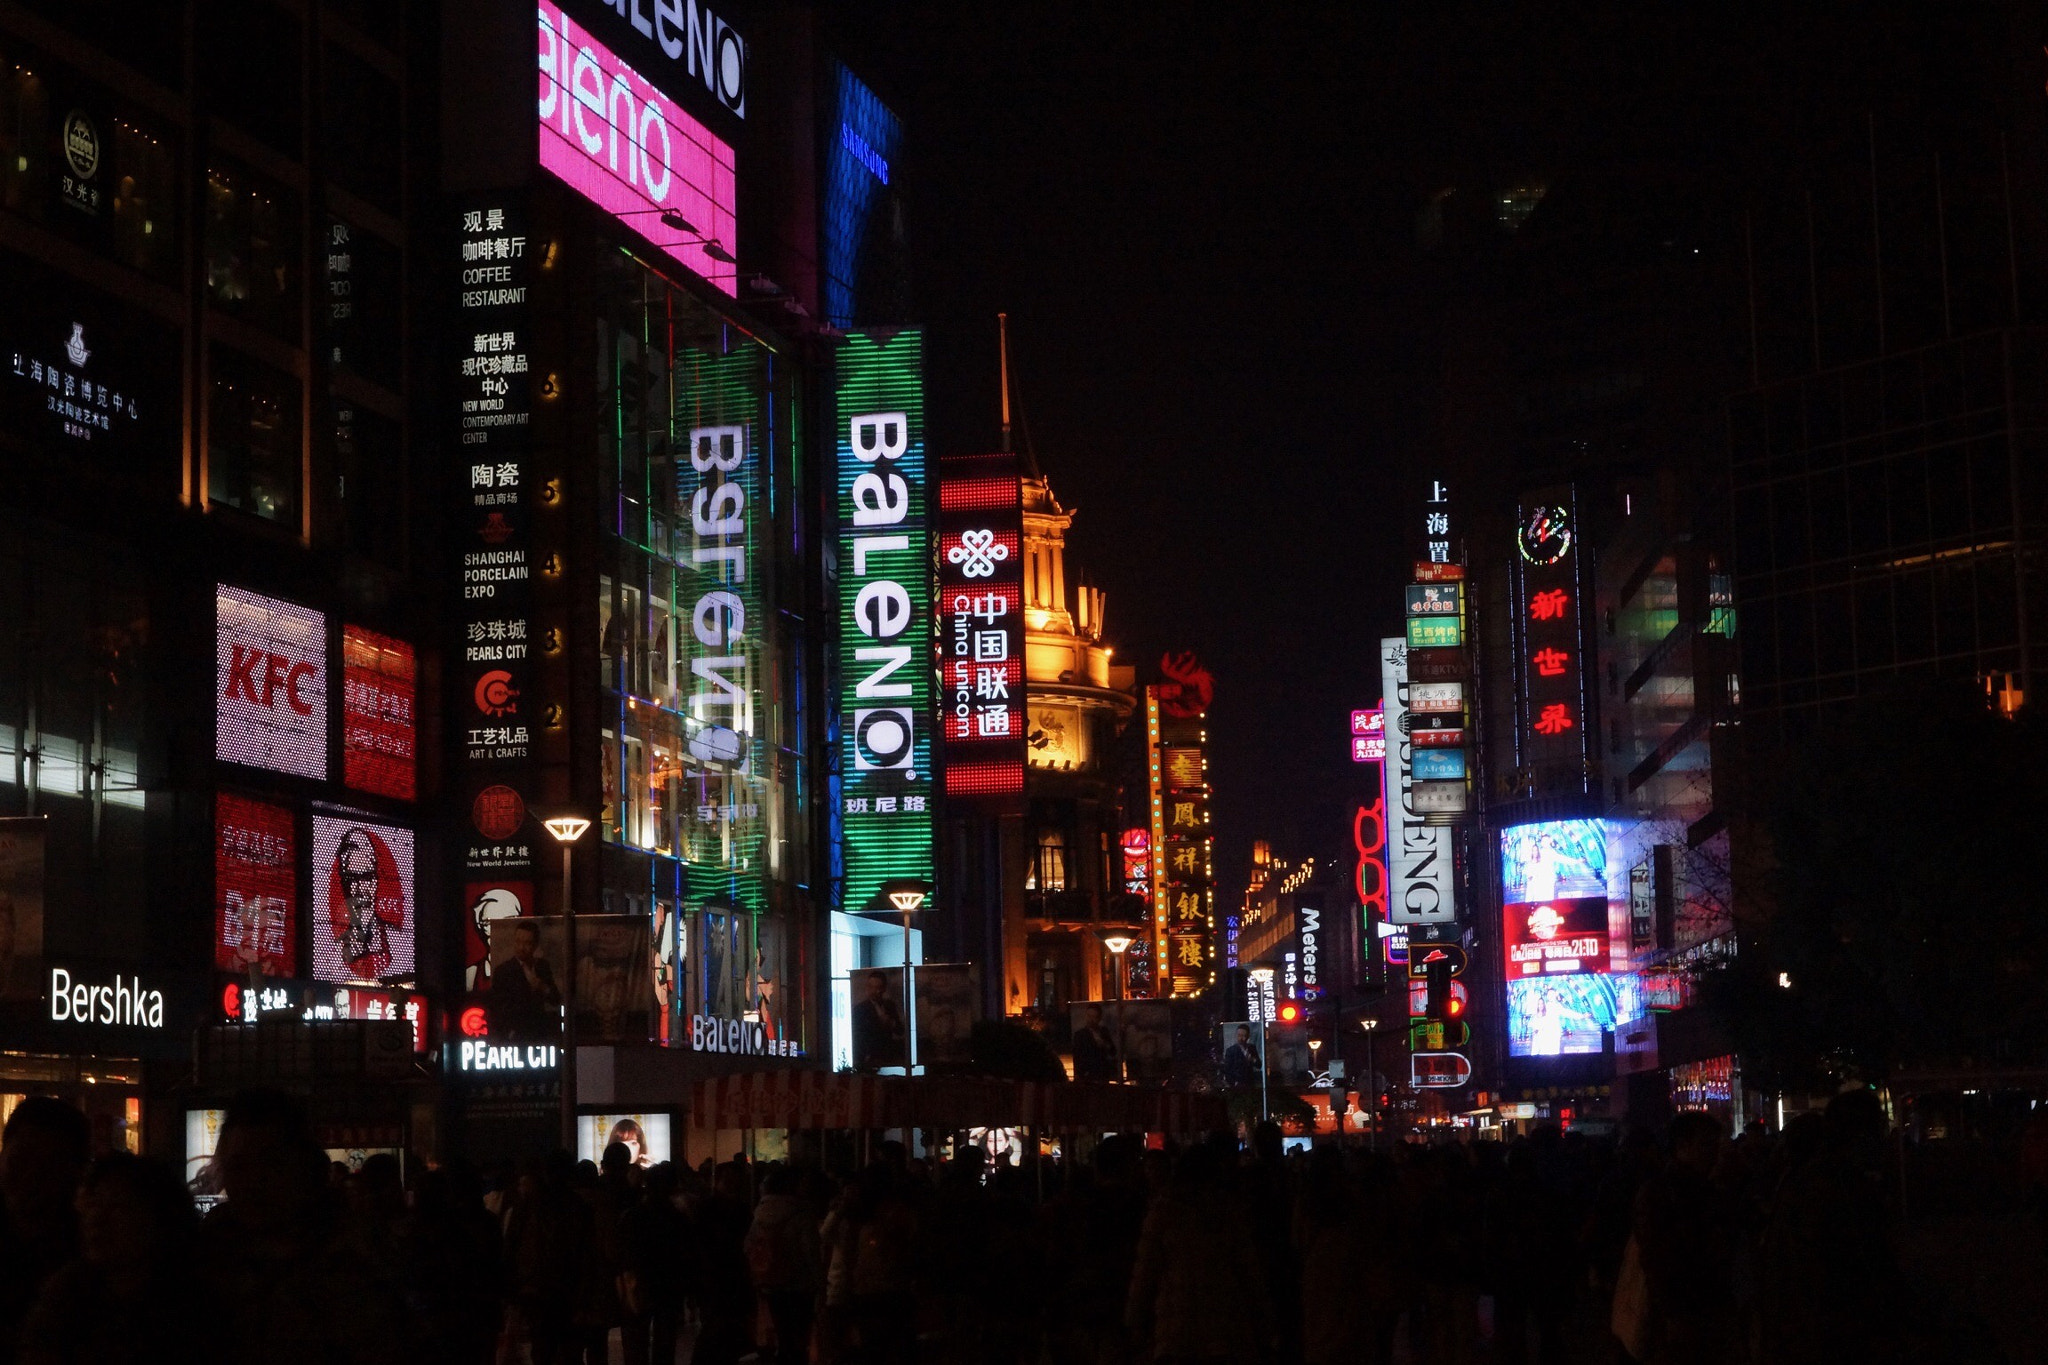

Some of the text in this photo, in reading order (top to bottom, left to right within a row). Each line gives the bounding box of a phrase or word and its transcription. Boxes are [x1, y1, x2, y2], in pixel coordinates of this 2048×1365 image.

[842, 121, 889, 186] SAMSUNG
[463, 208, 505, 233] 观景
[462, 236, 527, 262] 咖啡餐厅
[463, 265, 512, 285] COFFEE
[462, 287, 527, 307] RESTAURANT
[474, 332, 516, 353] 新世界
[461, 354, 528, 376] 现代珍藏品
[13, 353, 138, 420] 上海陶瓷博览中心
[481, 377, 509, 397] 中心
[462, 398, 504, 413] NEW WORLD
[462, 413, 529, 429] CONTEMPORARY ART
[462, 431, 488, 444] CENTER
[471, 461, 520, 489] 陶瓷
[474, 492, 518, 506] 精品商场
[464, 550, 525, 566] SHANGHAI
[464, 566, 529, 583] PORCELAIN
[464, 584, 495, 599] EXPO
[467, 618, 527, 642] 珍珠城
[466, 644, 528, 661] PEARLS CITY
[1530, 588, 1572, 735] 新世界
[974, 592, 1010, 736] 中国联通
[225, 642, 315, 715] KFC
[955, 660, 973, 738] unicom
[467, 727, 529, 745] 工艺礼品
[469, 747, 527, 759] ART & CRAFTS
[845, 796, 926, 813] 班尼路
[482, 859, 502, 867] World
[503, 859, 531, 867] Jewelers
[51, 968, 163, 1029] Bershka
